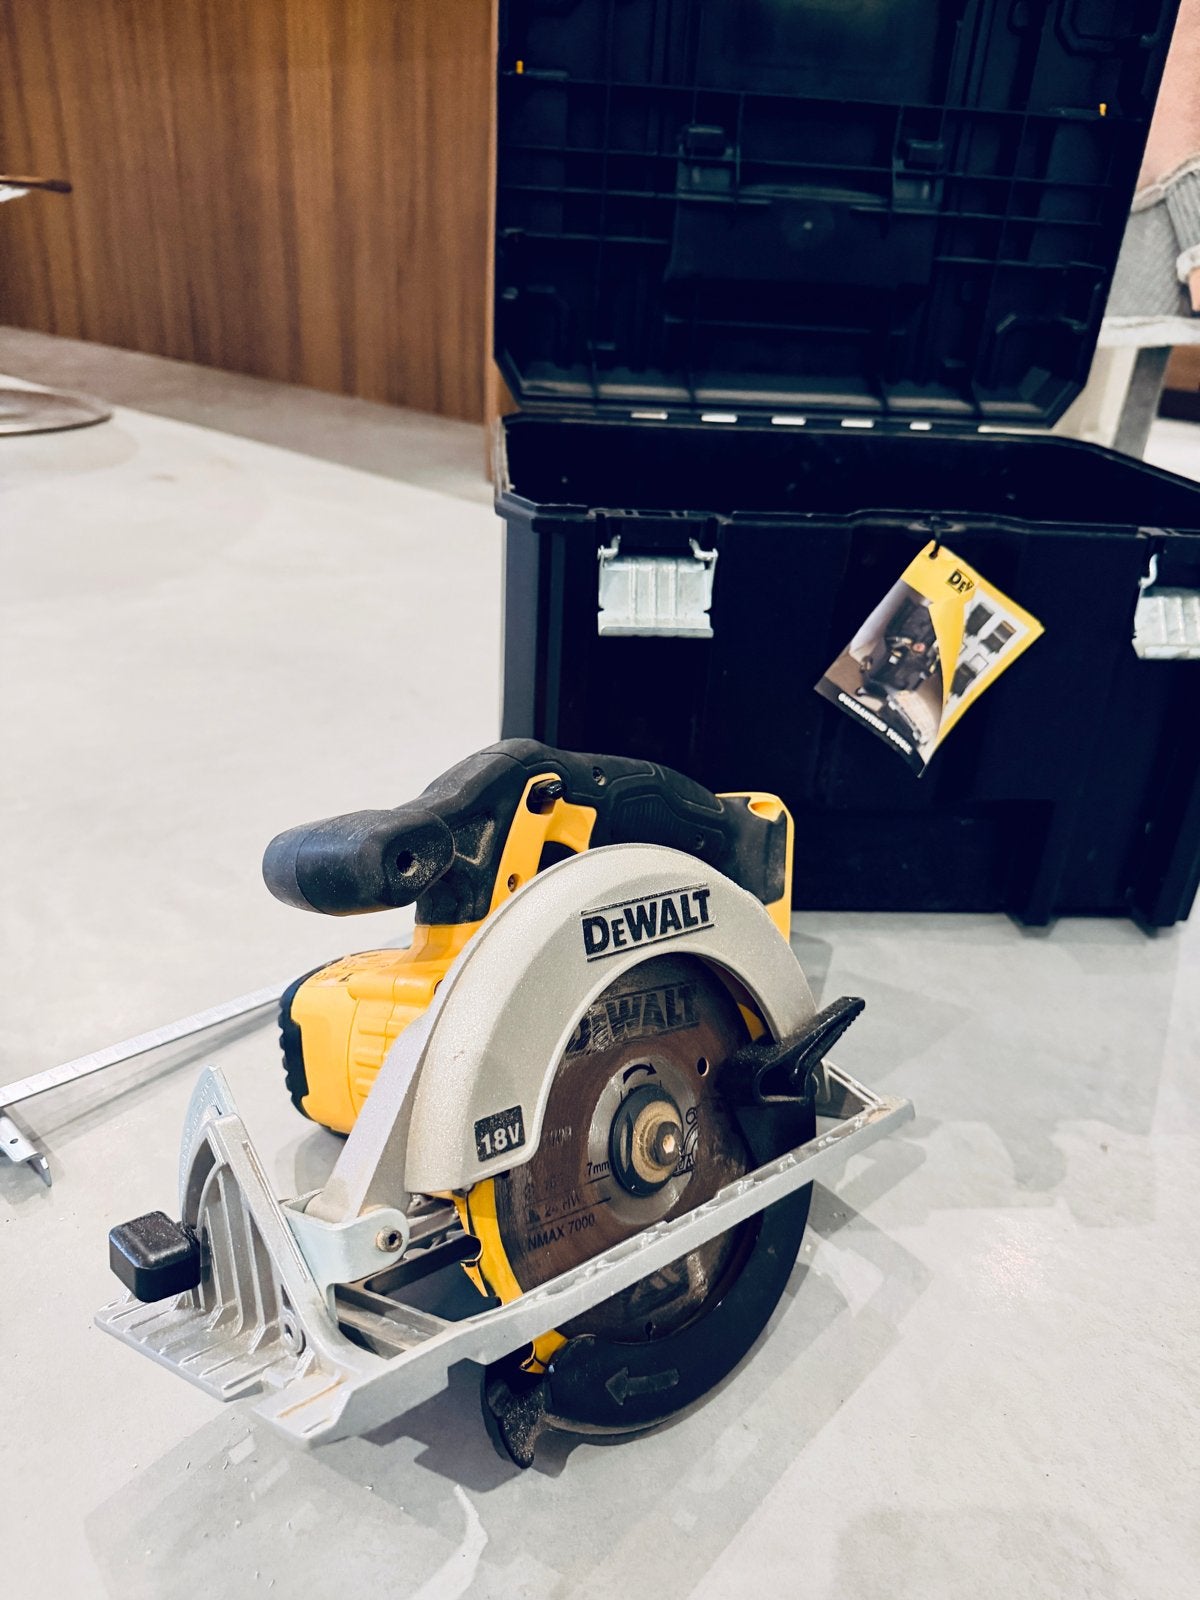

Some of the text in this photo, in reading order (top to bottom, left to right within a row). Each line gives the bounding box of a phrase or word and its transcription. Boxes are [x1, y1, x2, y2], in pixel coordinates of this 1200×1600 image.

[582, 888, 711, 955] DEWALT
[481, 1122, 520, 1155] 18V
[568, 1213, 596, 1235] 7000
